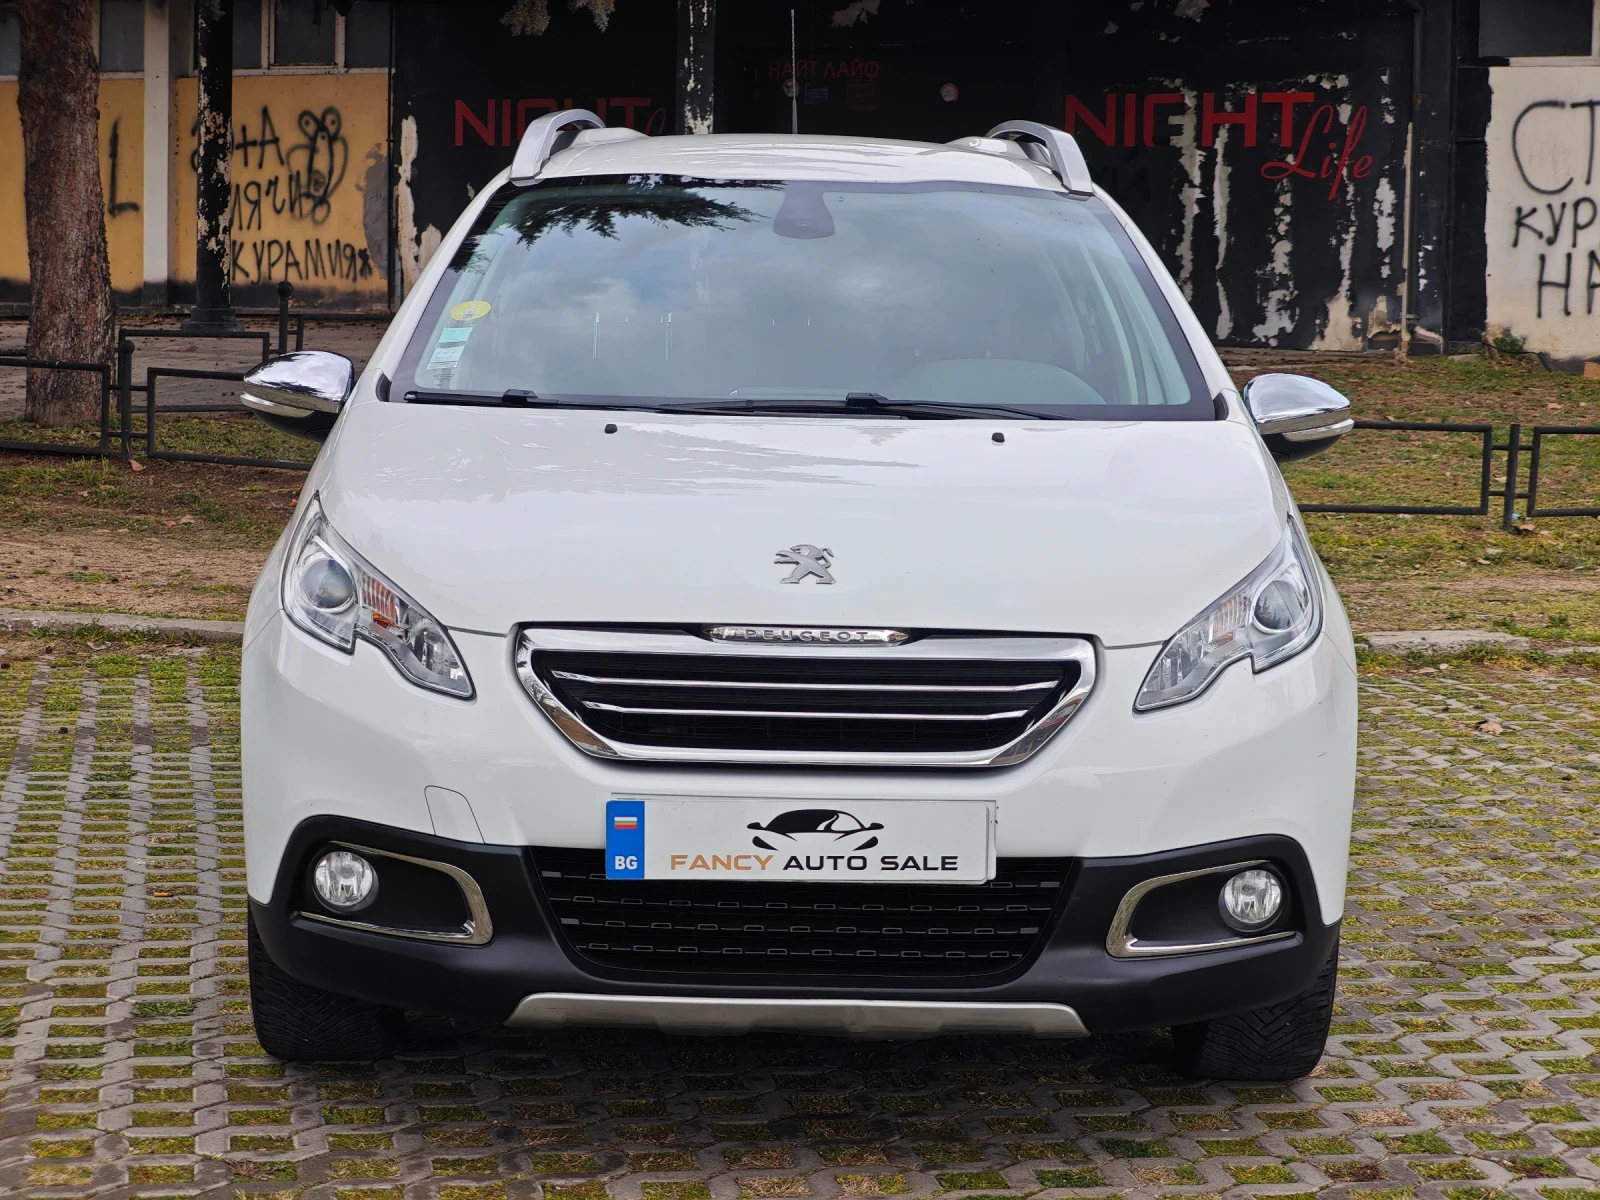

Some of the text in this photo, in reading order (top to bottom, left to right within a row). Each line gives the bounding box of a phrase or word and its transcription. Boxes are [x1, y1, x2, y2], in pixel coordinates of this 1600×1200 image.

[768, 58, 880, 80] НАЙТ ЛАЙФ
[1261, 104, 1372, 200] Life
[1512, 197, 1598, 248] КУР
[744, 628, 869, 642] PEUGEOT
[614, 855, 638, 871] BG
[670, 854, 959, 872] FANCY AUTO SALE
